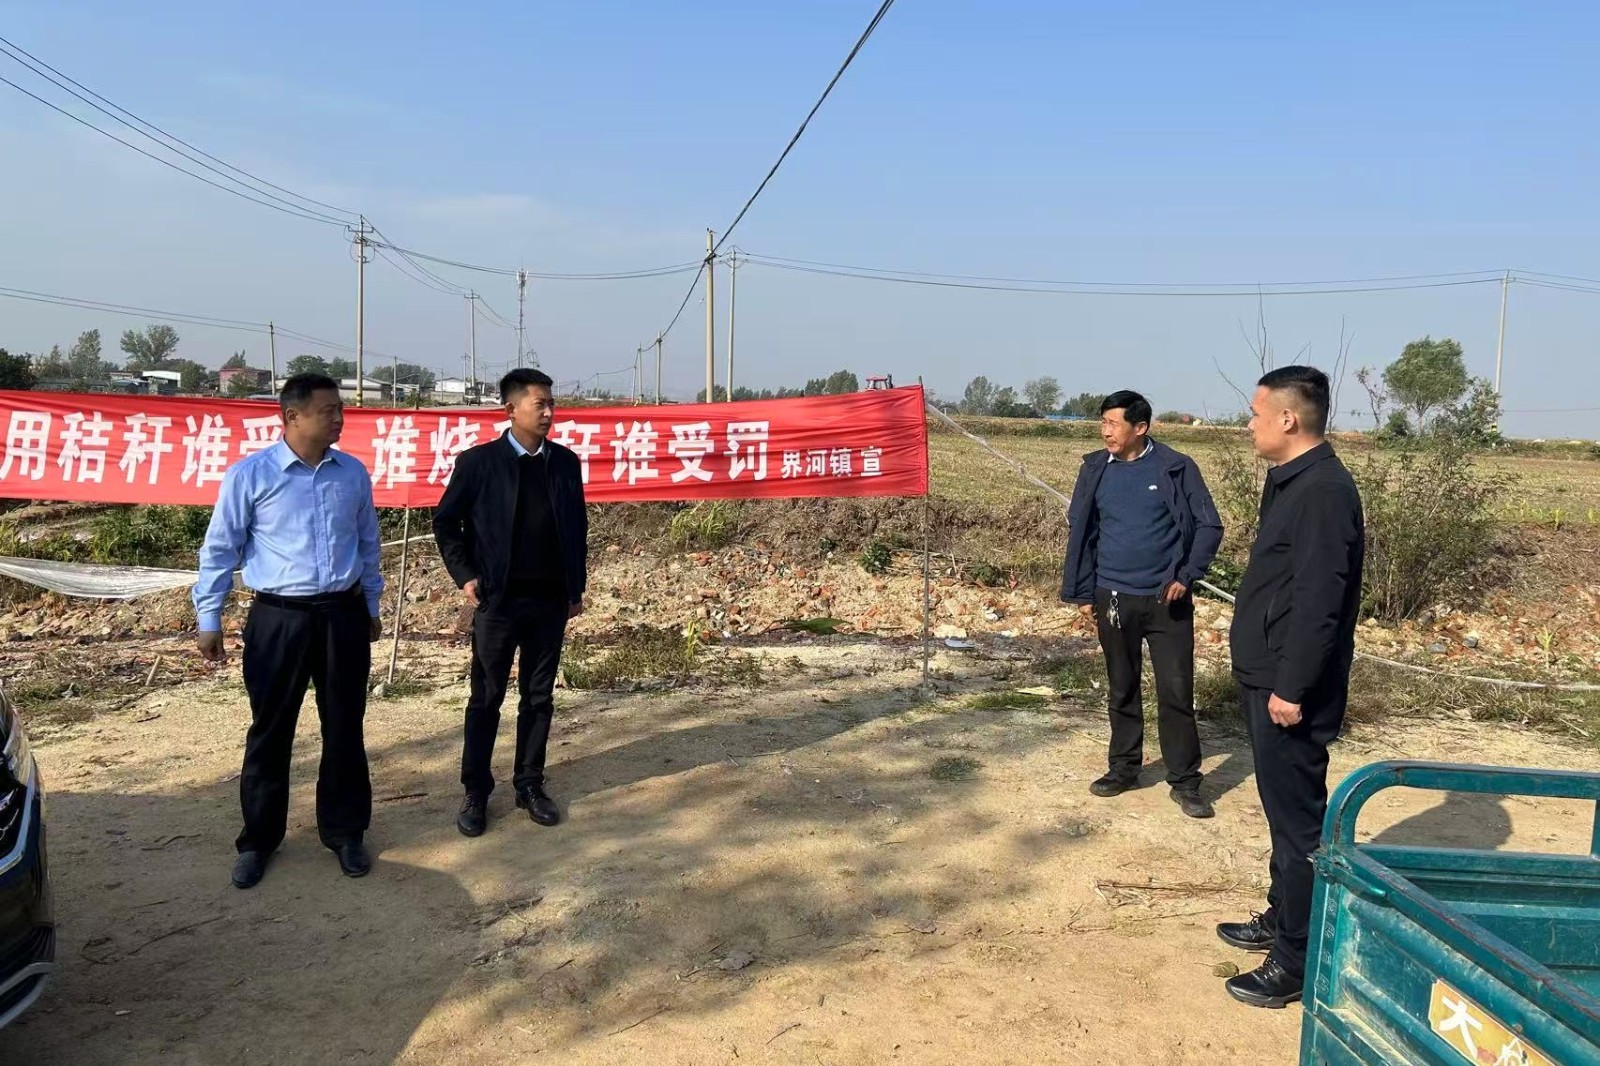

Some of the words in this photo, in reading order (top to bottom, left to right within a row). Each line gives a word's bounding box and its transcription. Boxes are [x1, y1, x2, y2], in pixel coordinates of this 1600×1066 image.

[0, 411, 341, 488] 用秸秆谁受
[370, 416, 770, 490] 谁烧秆谁受罚
[781, 447, 852, 478] 界河镇
[860, 445, 882, 477] 宣
